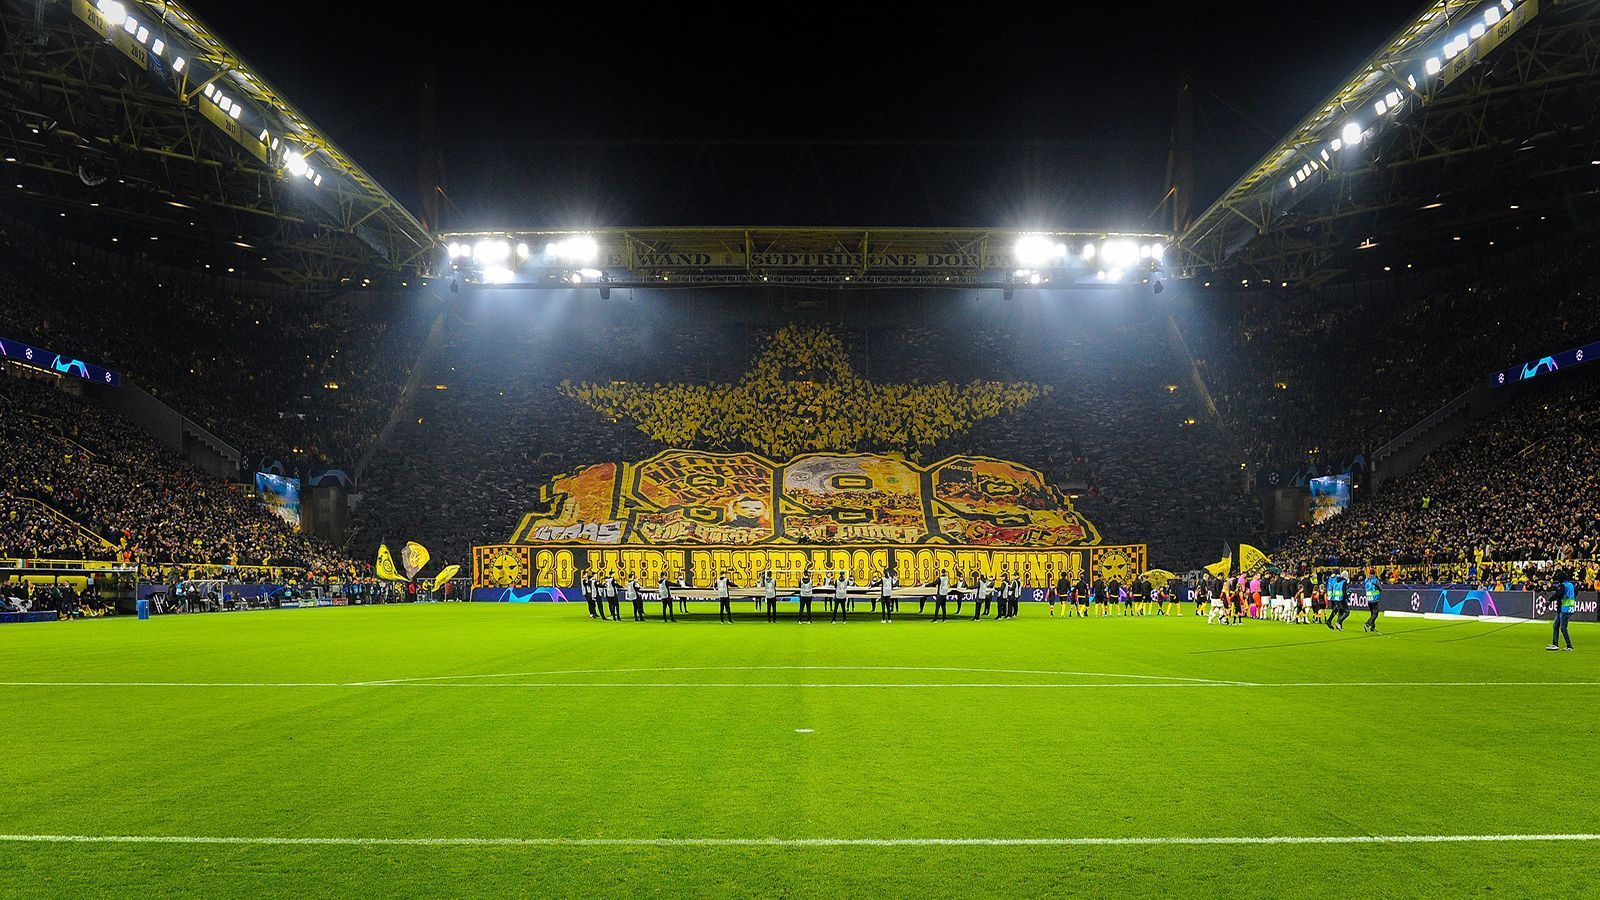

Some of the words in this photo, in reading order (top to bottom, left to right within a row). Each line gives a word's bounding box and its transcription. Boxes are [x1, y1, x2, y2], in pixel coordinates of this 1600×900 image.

[88, 9, 103, 30] 2012
[131, 43, 145, 63] 2012
[636, 254, 713, 265] WAND
[536, 550, 577, 588] 20
[586, 550, 686, 588] JAHRE
[690, 550, 888, 588] DESPERADOS
[894, 549, 1085, 588] DORTMUND!
